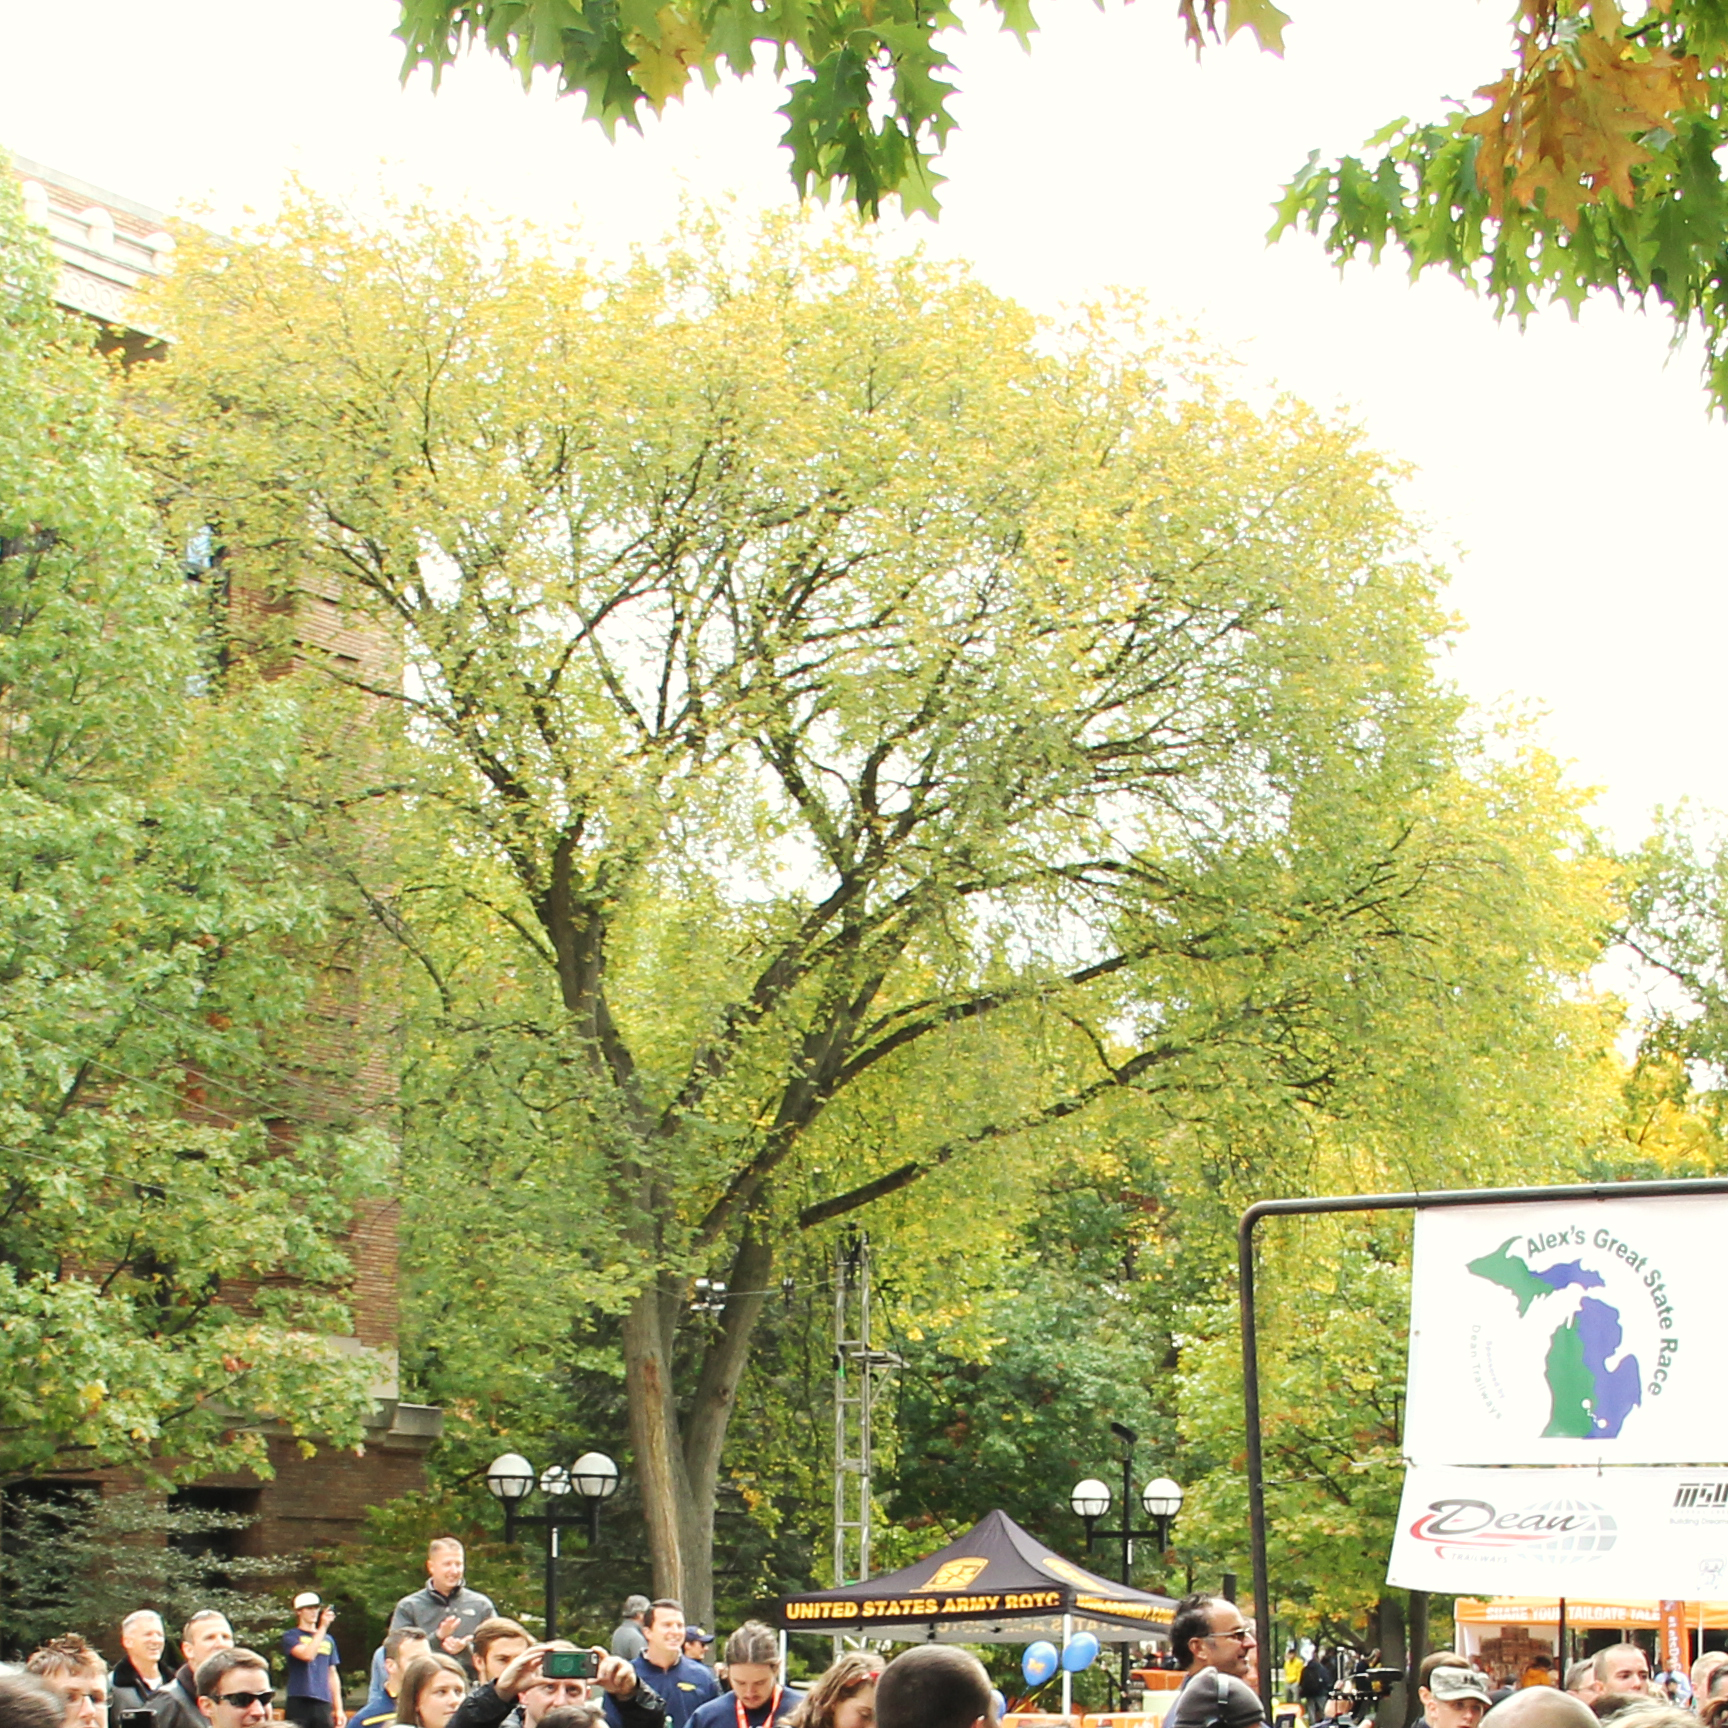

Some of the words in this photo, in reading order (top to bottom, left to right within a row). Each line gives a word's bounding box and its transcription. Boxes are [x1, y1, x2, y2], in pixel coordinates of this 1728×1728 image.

[1527, 1225, 1585, 1258] Alex's
[1593, 1228, 1648, 1274] Great
[1643, 1269, 1674, 1330] State
[1470, 1324, 1481, 1358] Dean
[1647, 1338, 1678, 1396] Race
[1472, 1363, 1502, 1420] Trailways
[1427, 1498, 1586, 1535] Dean
[1452, 1552, 1509, 1563] TRAILWAYS
[786, 1602, 858, 1620] UNITED
[862, 1599, 937, 1618] STATES
[941, 1595, 999, 1614] ARMY
[1004, 1592, 1060, 1608] ROTC
[1486, 1606, 1528, 1620] SHARE
[1567, 1605, 1626, 1620] TAILGATE
